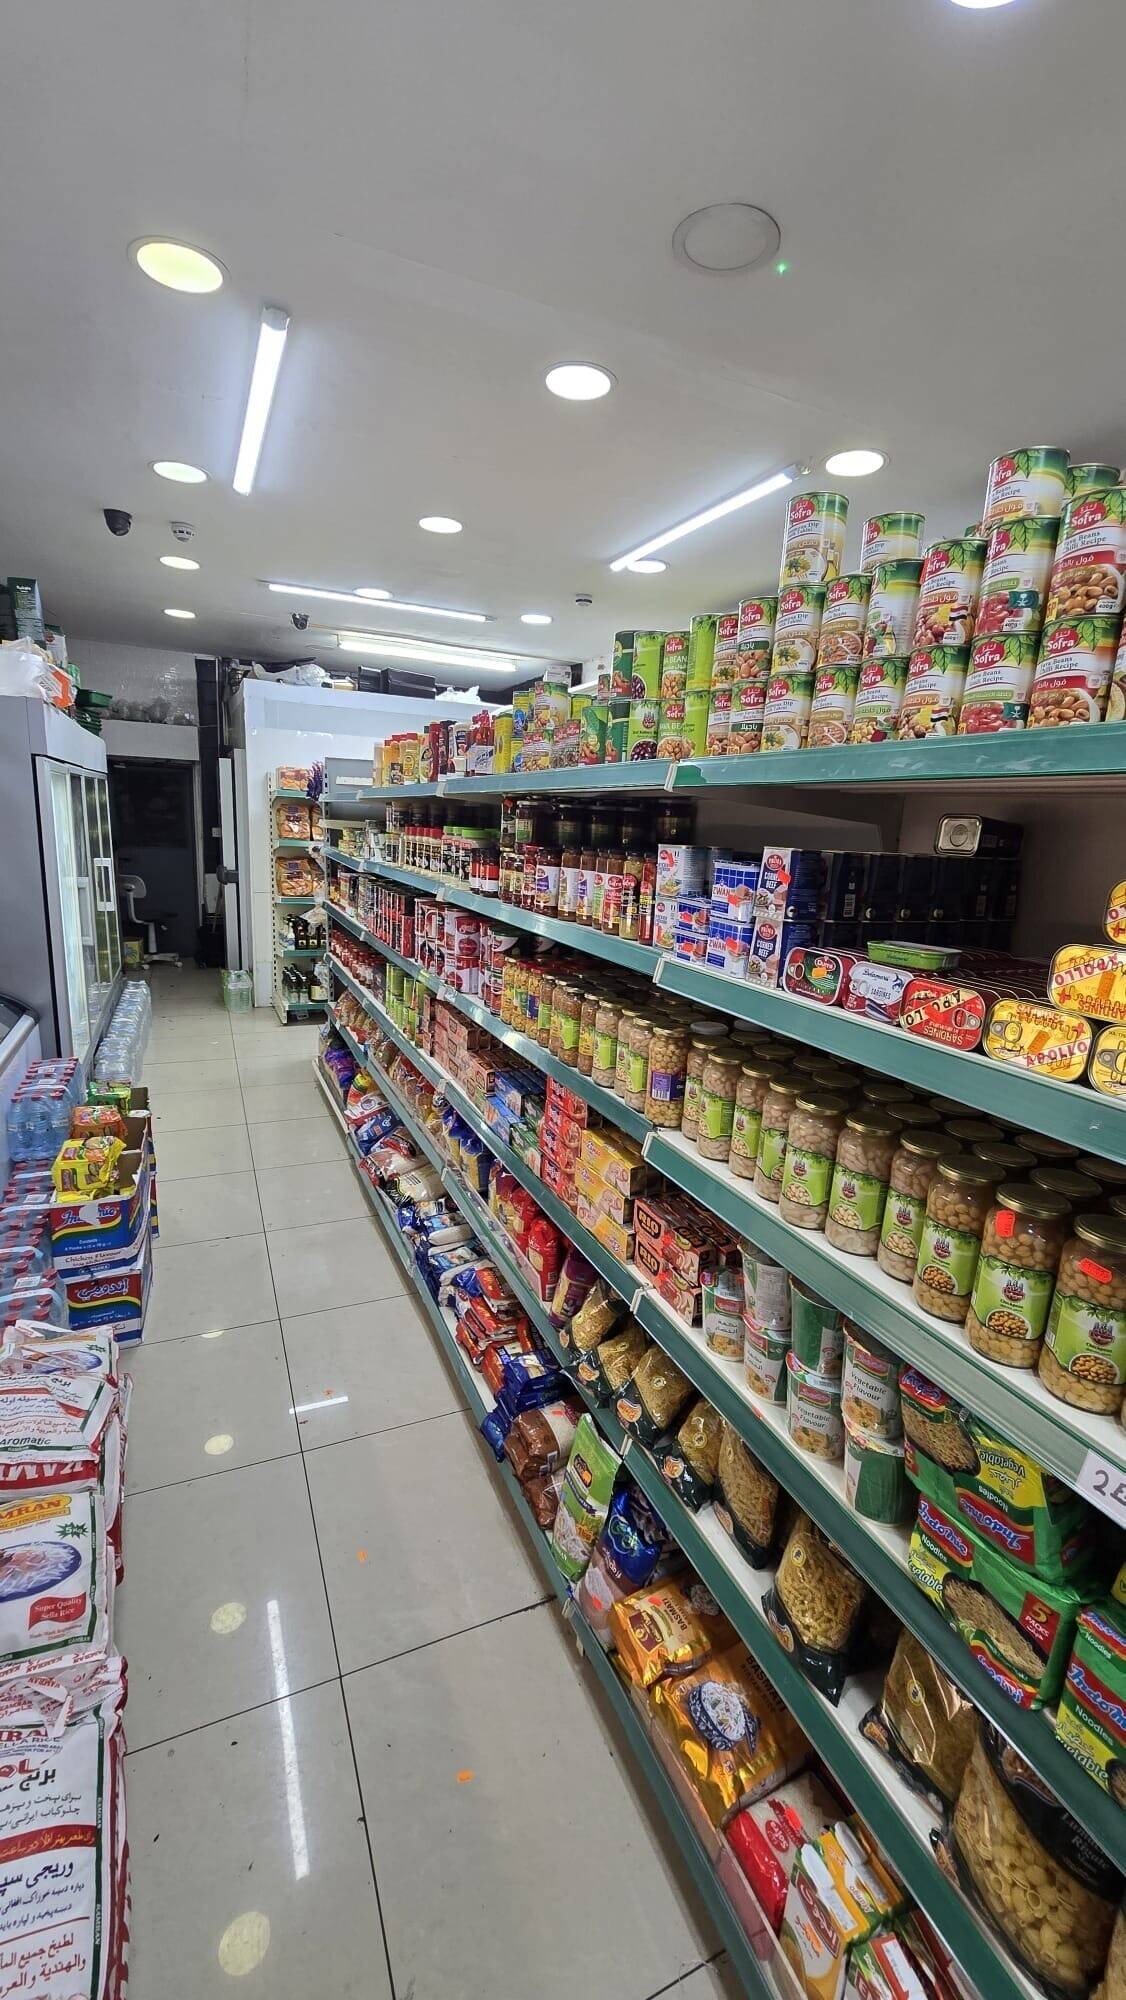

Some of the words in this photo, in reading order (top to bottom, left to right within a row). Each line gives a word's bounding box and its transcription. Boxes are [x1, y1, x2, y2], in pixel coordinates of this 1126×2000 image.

[790, 509, 812, 520] Sofra
[1071, 512, 1102, 528] Sofra
[1078, 531, 1101, 541] Beans
[1080, 536, 1106, 548] Recipe
[829, 591, 848, 600] Sofra
[781, 601, 801, 611] Sofra
[741, 612, 761, 623] Sofra
[666, 643, 683, 652] Sofra
[1048, 638, 1074, 651] Sofra
[974, 653, 1000, 665] Sofra
[1053, 657, 1073, 666] Beans
[910, 663, 929, 673] Sofra
[1053, 662, 1079, 672] Recipe
[861, 674, 881, 684] Sofra
[816, 681, 832, 690] Sofra
[768, 688, 787, 698] Sofra
[741, 695, 765, 704] Sofra
[766, 880, 777, 889] BEEF
[712, 886, 731, 897] ZWAN
[708, 941, 727, 951] ZWAN
[756, 940, 774, 951] CORNED
[758, 948, 769, 957] BEEF
[870, 986, 892, 1000] SARDINES
[923, 1025, 964, 1046] SARDINES
[639, 1210, 660, 1234] RIO
[65, 1255, 94, 1263] Chicken
[639, 1248, 658, 1274] RIO
[851, 1371, 887, 1395] Vegetable
[853, 1382, 882, 1402] Flavour
[797, 1404, 831, 1422] Vegetable
[799, 1414, 826, 1429] Flavour
[980, 1450, 1026, 1479] Vegetable
[978, 1485, 1009, 1513] Noodles
[919, 1500, 968, 1557] Indomie
[921, 1533, 948, 1564] Noodles
[35, 1603, 56, 1612] Super
[56, 1598, 82, 1609] Quality
[59, 1608, 76, 1617] Rice
[662, 1598, 688, 1631] BASMATI
[1029, 1602, 1052, 1623] 5
[1025, 1615, 1049, 1637] PACKS
[1085, 1631, 1113, 1660] Noodles
[1075, 1704, 1114, 1746] Noodles
